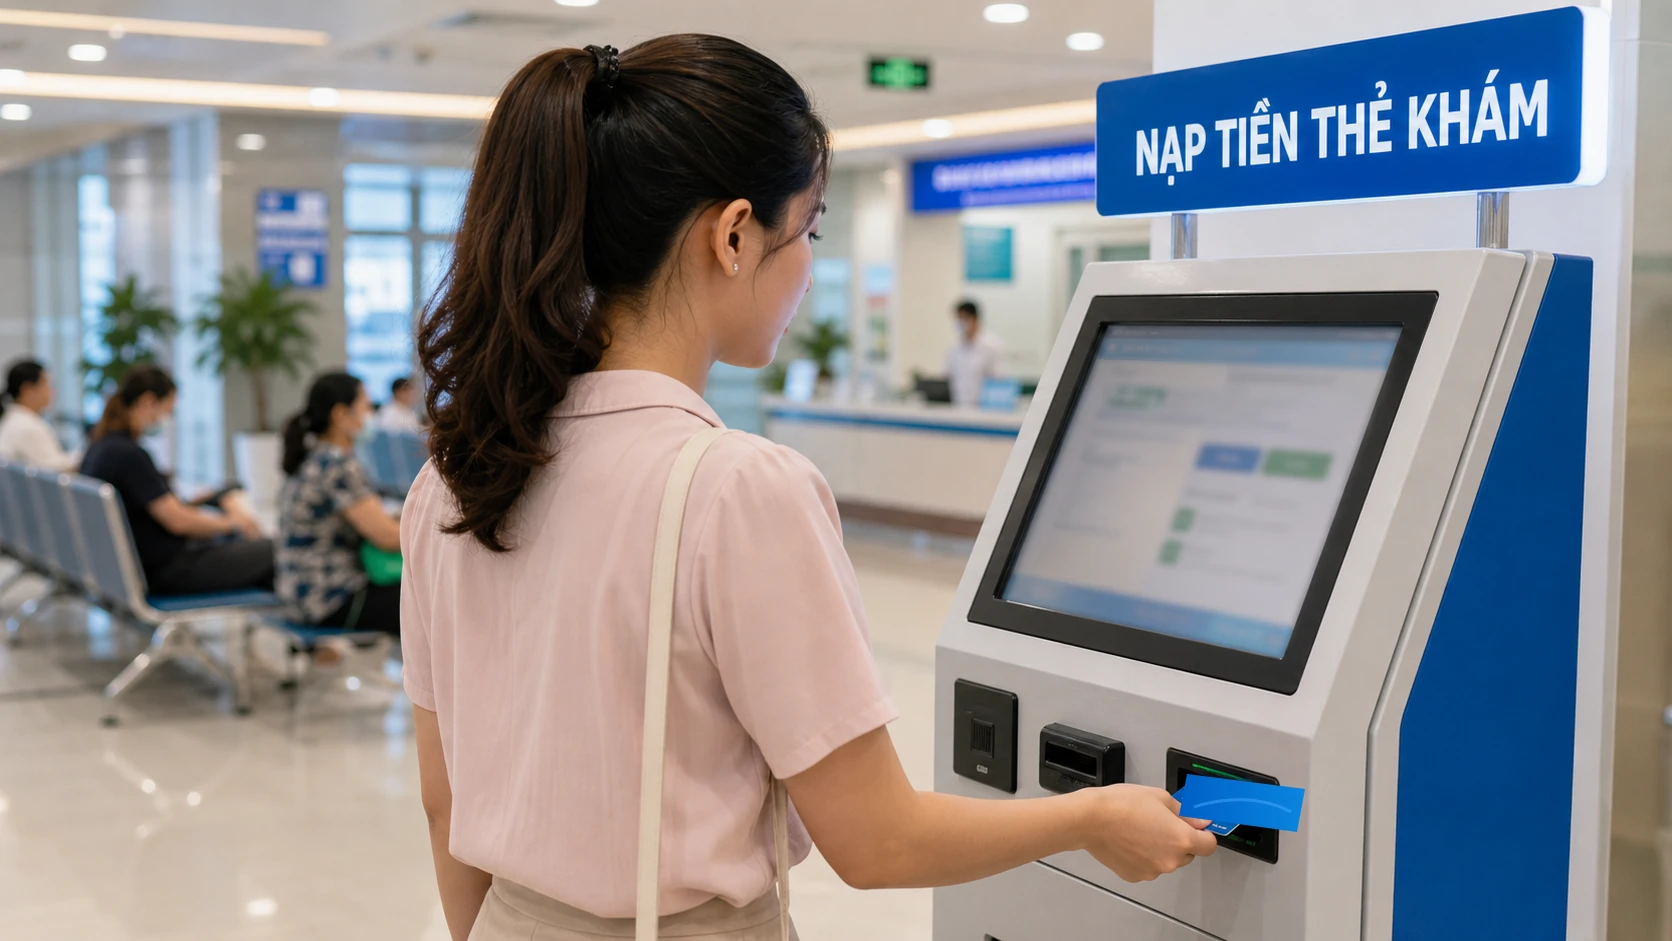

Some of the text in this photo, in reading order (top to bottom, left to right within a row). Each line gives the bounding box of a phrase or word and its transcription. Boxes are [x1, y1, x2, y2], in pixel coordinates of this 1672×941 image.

[1136, 123, 1206, 186] NẠP
[1215, 98, 1298, 168] TIỀN
[1311, 80, 1393, 158] THẺ
[1408, 69, 1548, 150] KHÁM
